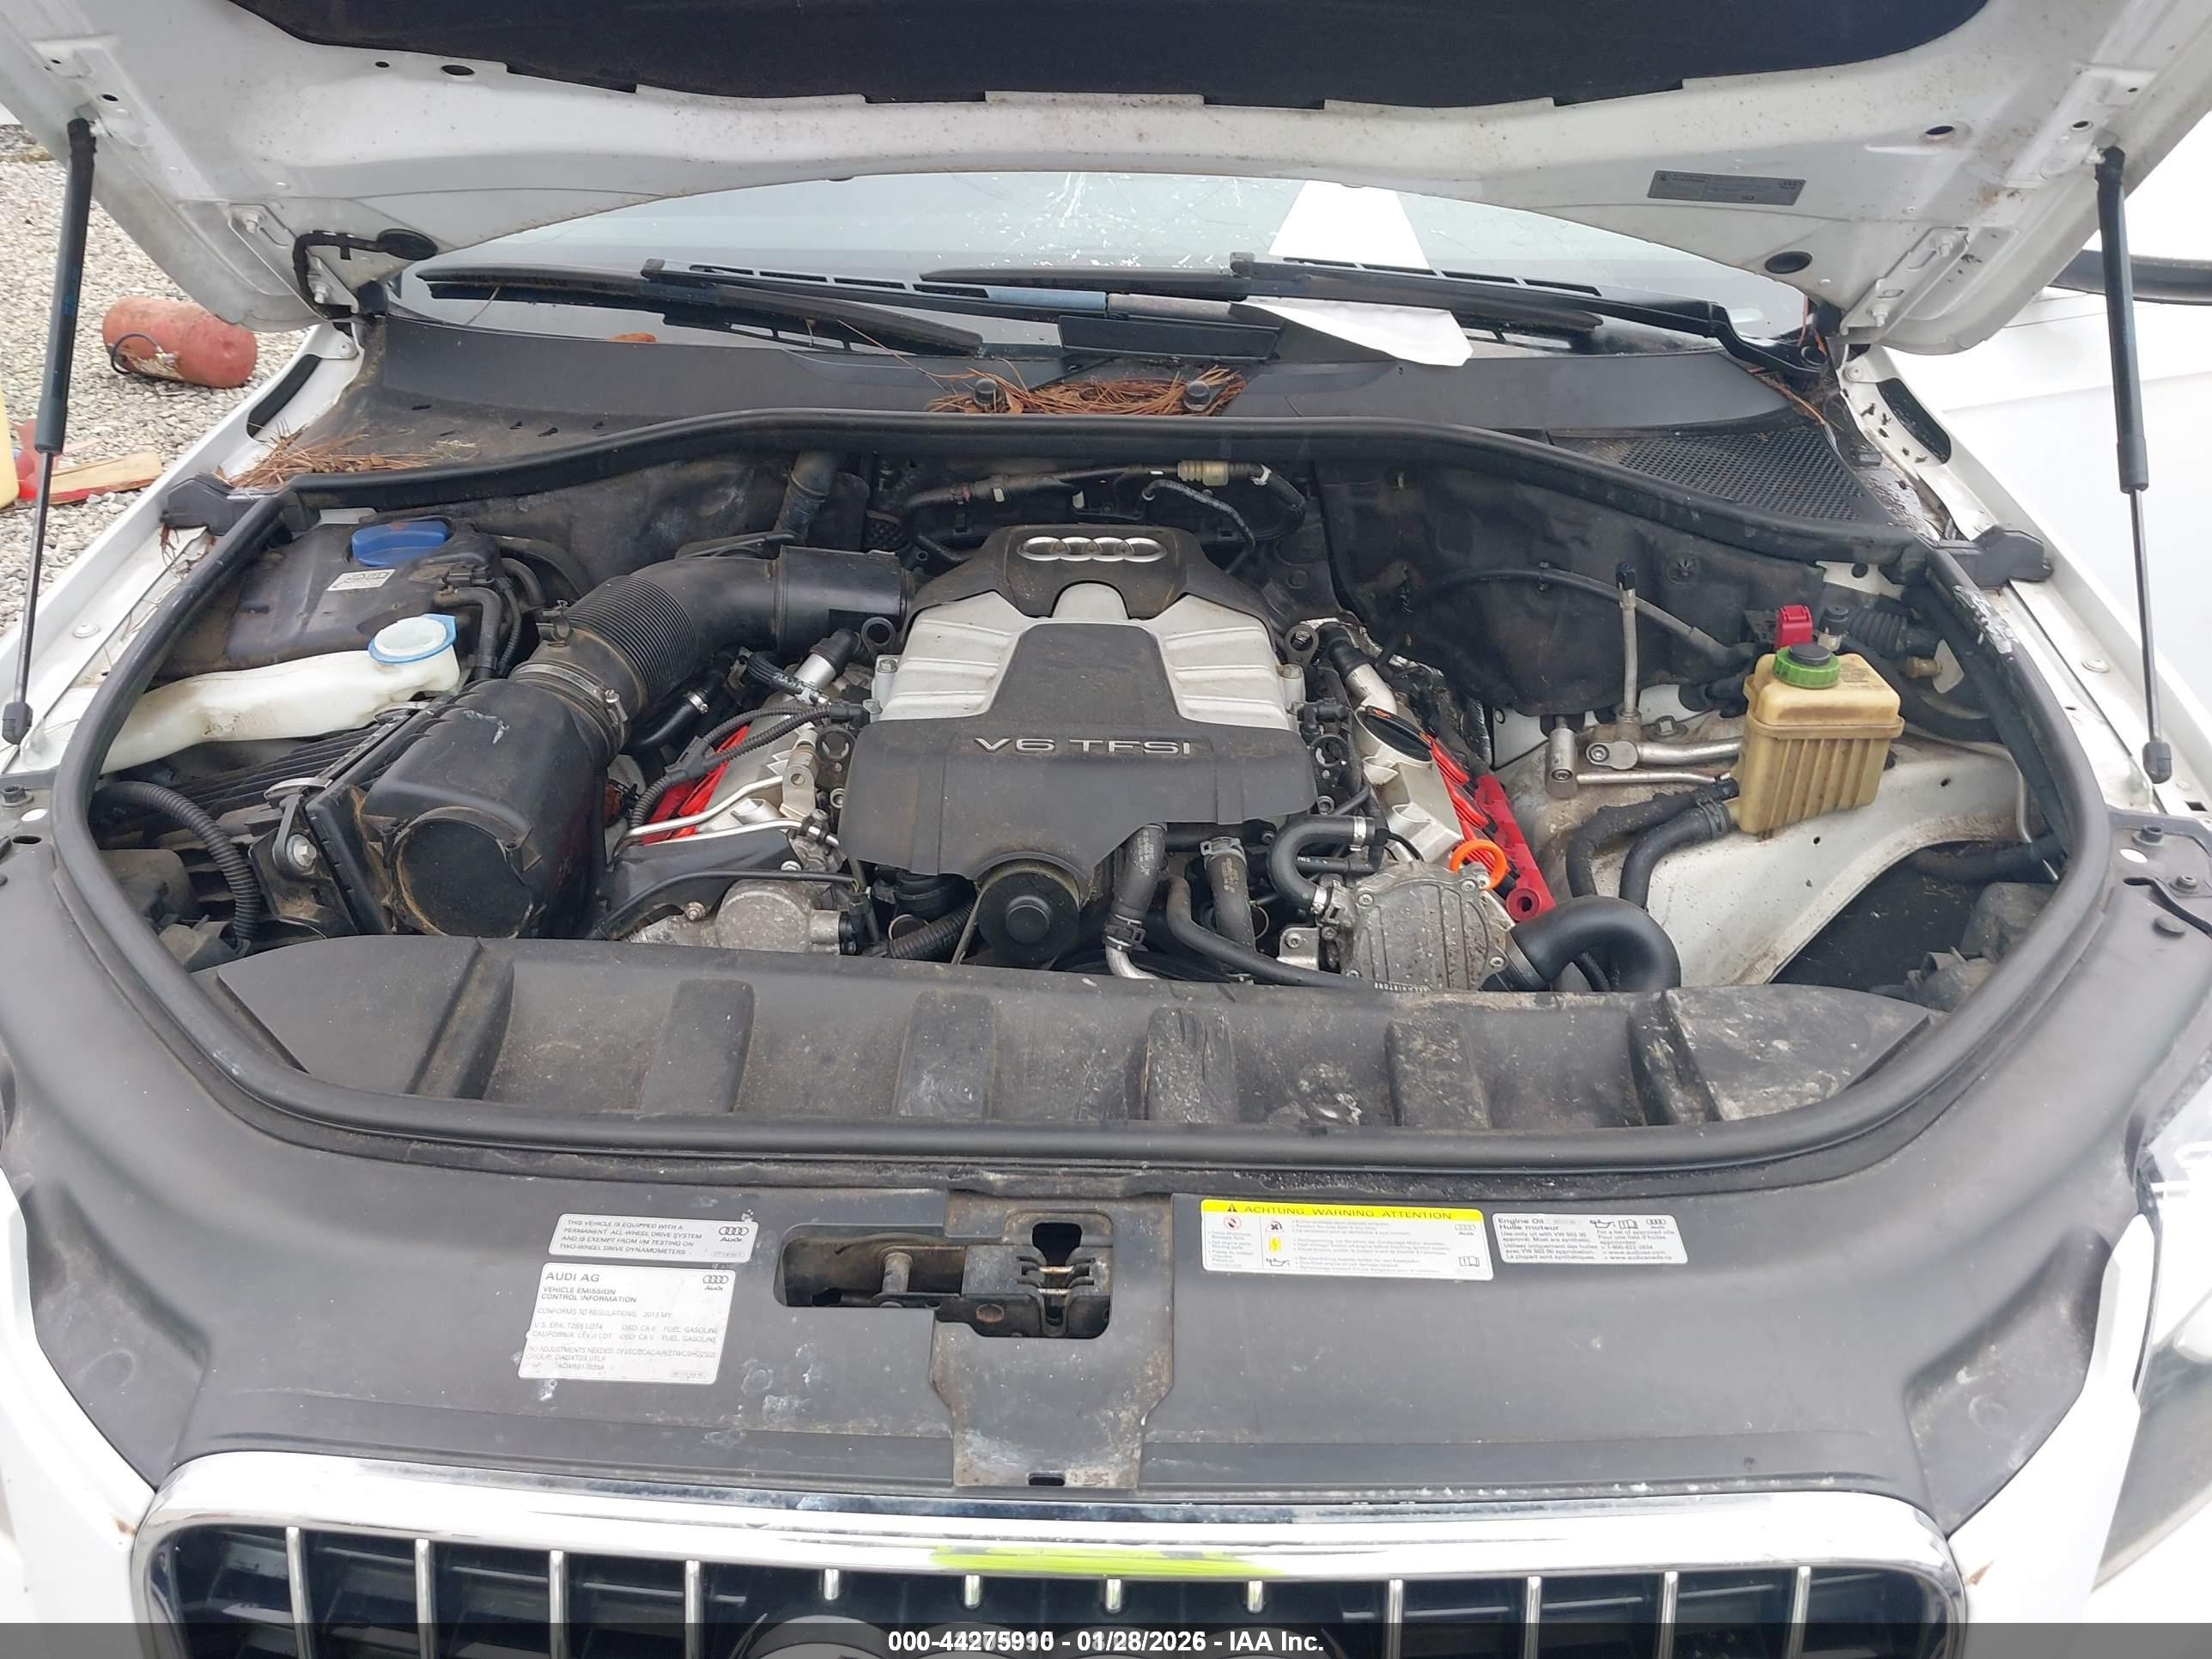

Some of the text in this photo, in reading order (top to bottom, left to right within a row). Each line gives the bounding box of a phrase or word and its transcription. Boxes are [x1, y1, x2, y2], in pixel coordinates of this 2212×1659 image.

[974, 737, 1190, 755] V6 TFSI
[1244, 1206, 1452, 1219] ACHTUNG WARNING ATTENTION
[559, 1243, 602, 1251] TWO-WHEEL
[625, 1246, 686, 1255] DYNAMOMETERS
[544, 1272, 601, 1282] AUDI AG
[541, 1292, 637, 1303] CONTROL INFORMATION
[682, 1334, 718, 1344] GASOLINE
